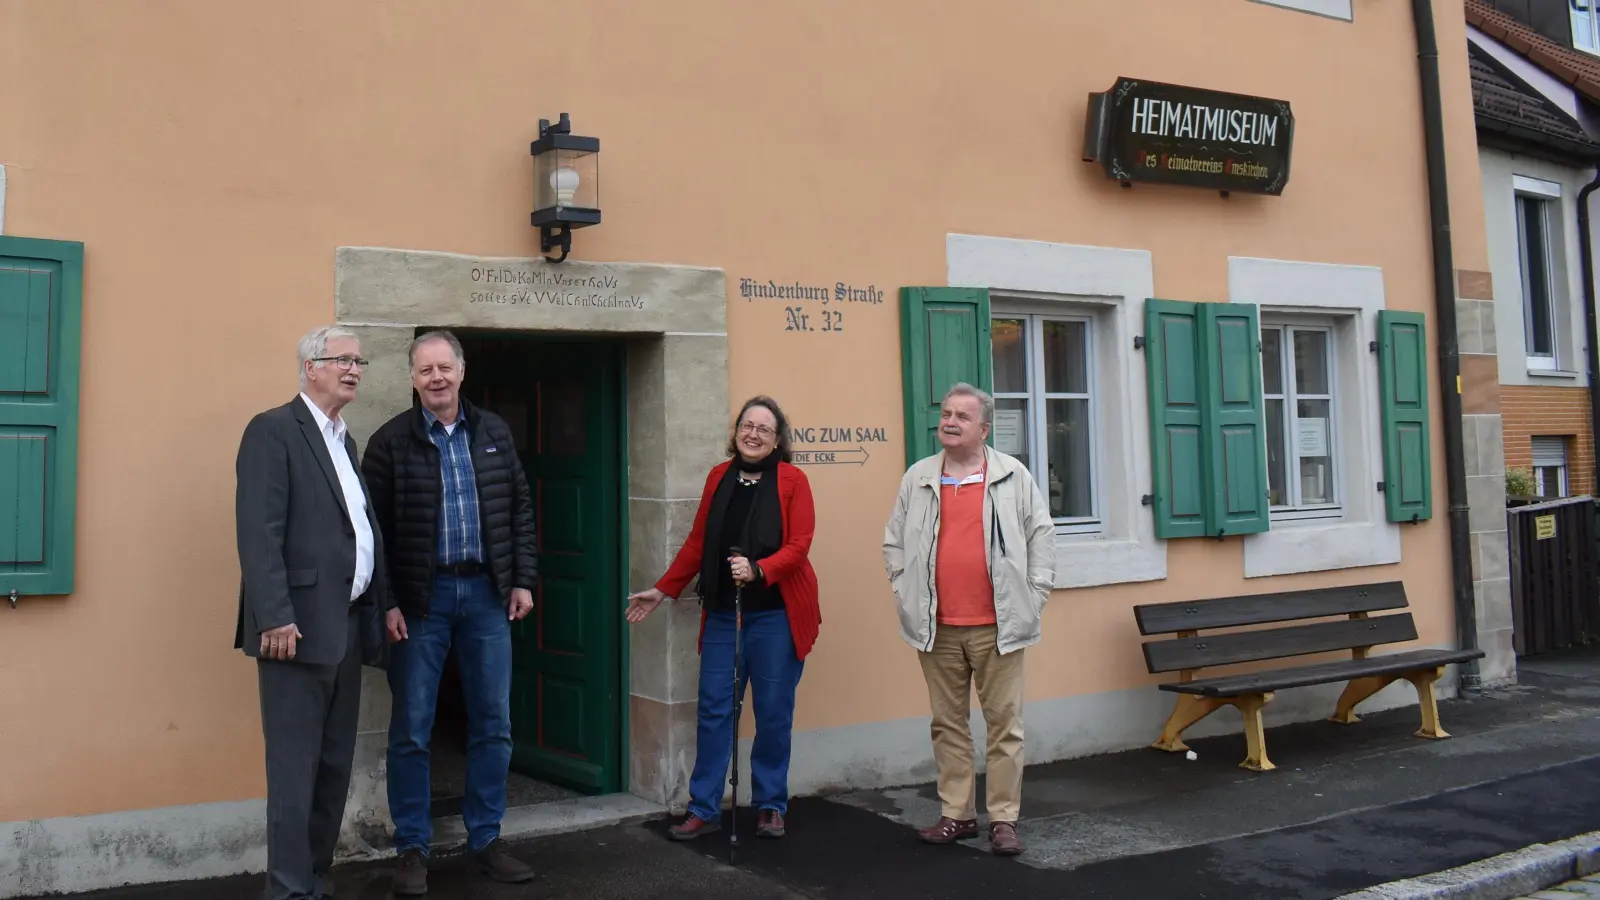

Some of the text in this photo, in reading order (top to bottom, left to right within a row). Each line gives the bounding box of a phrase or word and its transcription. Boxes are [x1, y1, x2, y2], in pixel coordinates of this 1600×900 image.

[1131, 98, 1278, 146] HEIMATMUSEUM
[740, 278, 883, 305] Hindenburg Straße
[785, 306, 843, 331] Nr. 32
[819, 427, 852, 443] ZUM
[855, 427, 888, 443] SAAL
[795, 452, 836, 463] DIE ECKE
